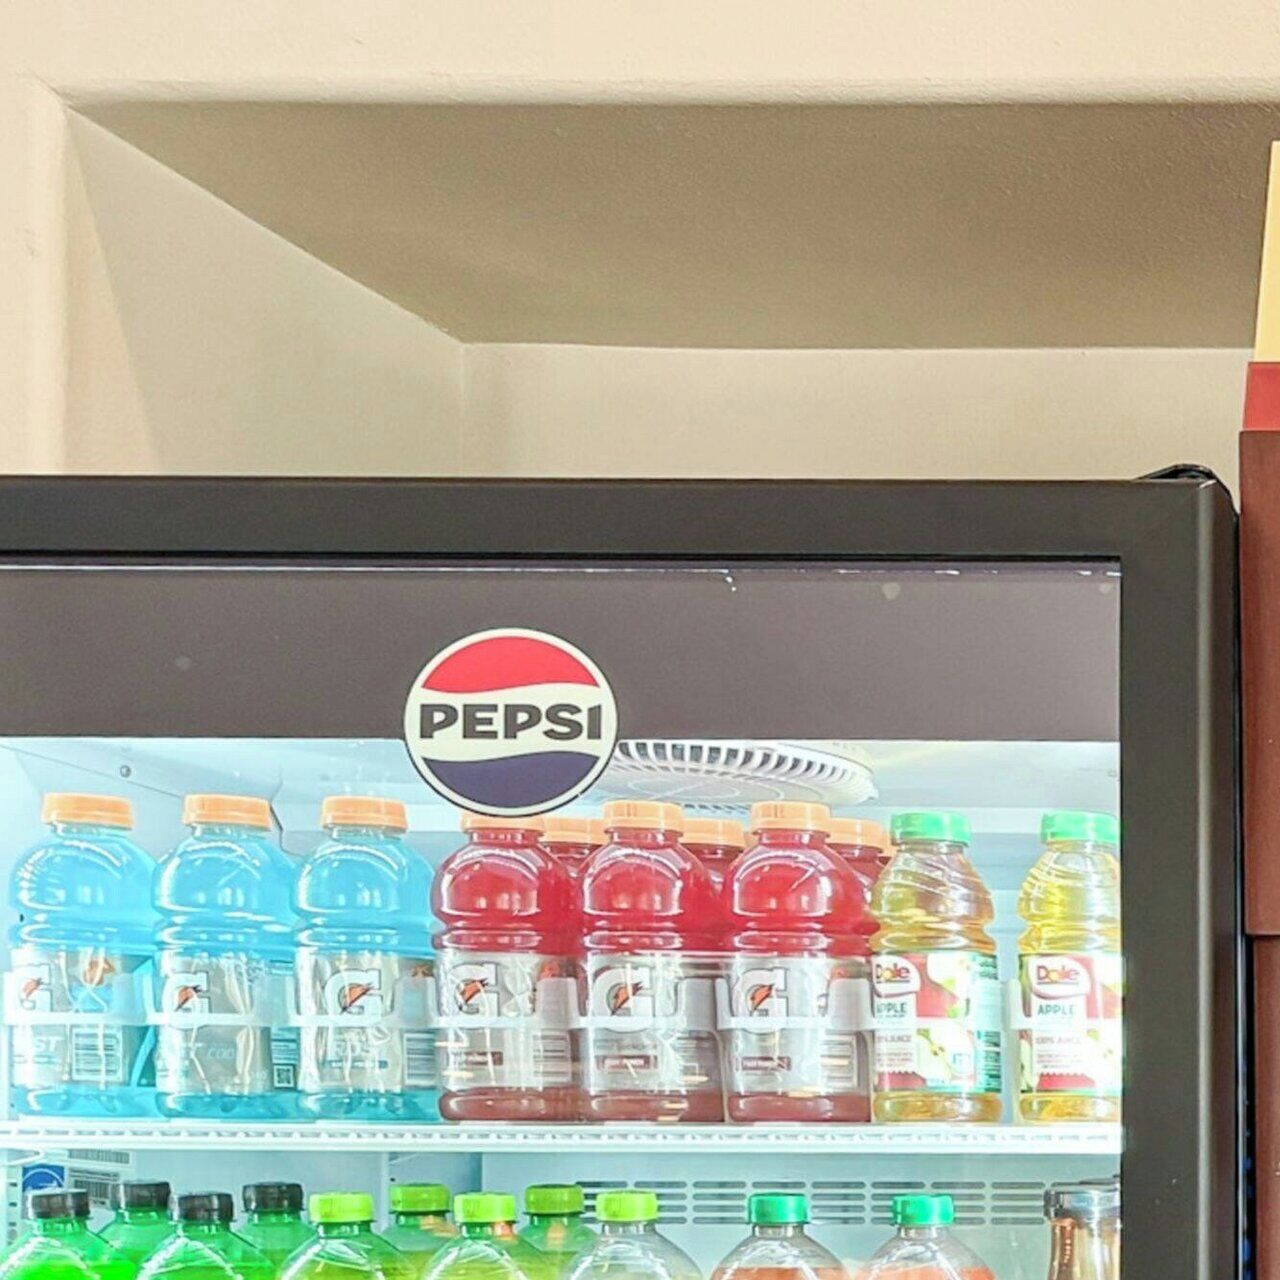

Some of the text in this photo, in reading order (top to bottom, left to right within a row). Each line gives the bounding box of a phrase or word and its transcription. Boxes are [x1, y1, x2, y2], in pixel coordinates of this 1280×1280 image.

[419, 703, 602, 740] PEPSI
[875, 962, 911, 980] Dole
[1036, 964, 1078, 981] Dole
[1037, 1003, 1076, 1017] APPLE
